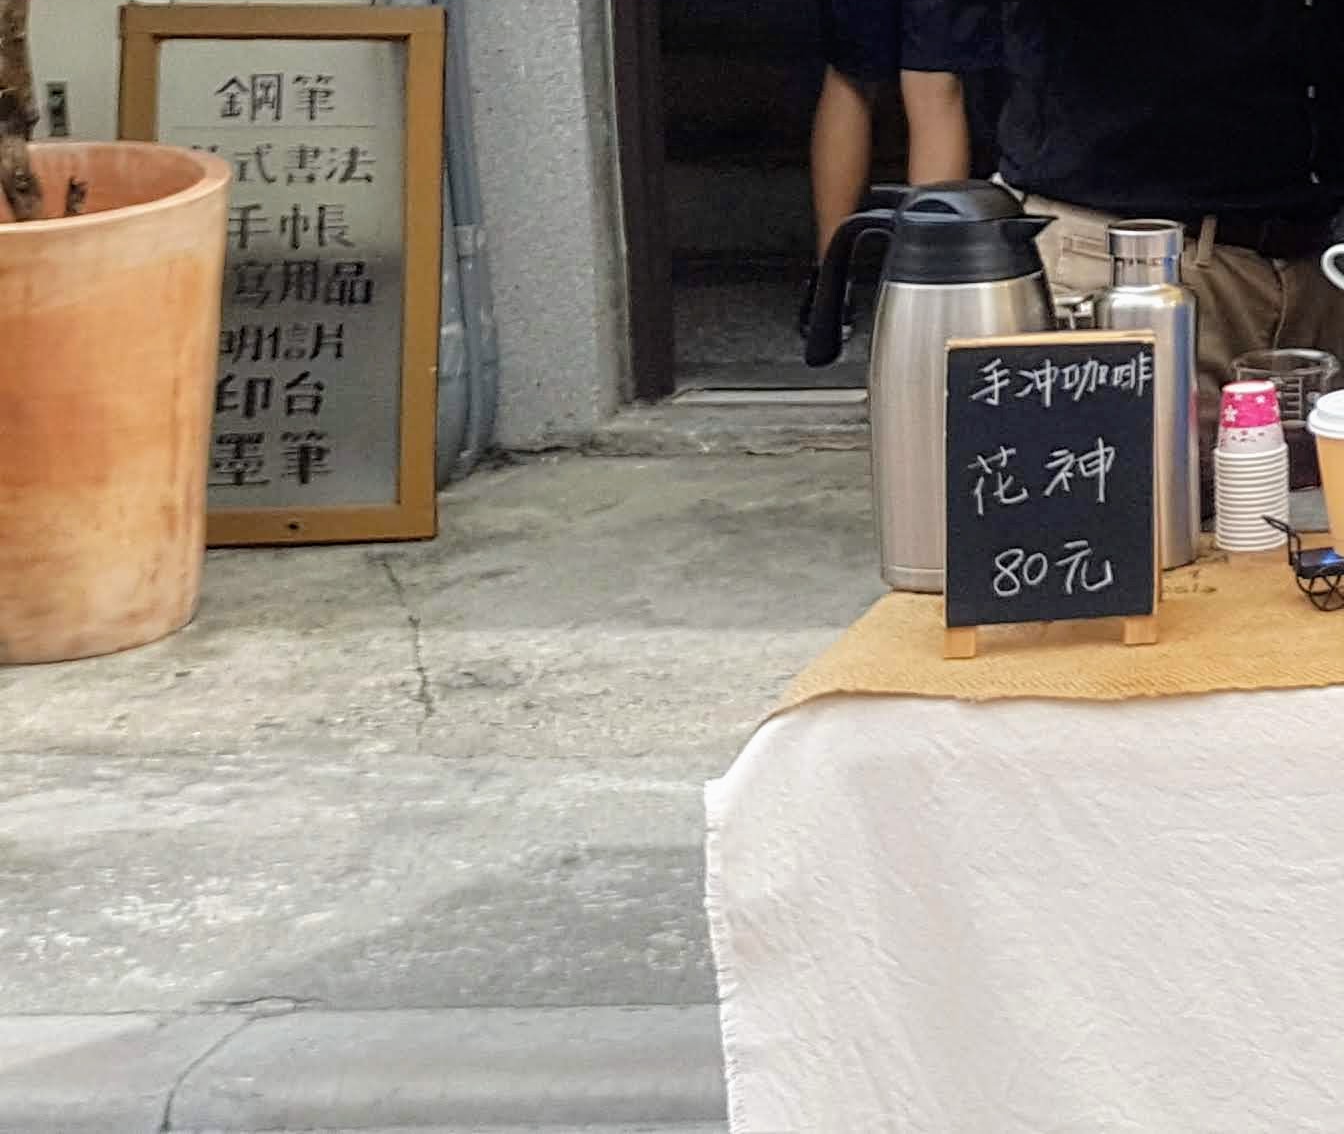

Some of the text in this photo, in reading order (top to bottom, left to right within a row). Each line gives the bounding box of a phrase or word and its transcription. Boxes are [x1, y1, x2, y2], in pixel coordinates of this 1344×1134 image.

[213, 72, 336, 123] 鋼筆
[192, 143, 377, 185] 式書法
[220, 322, 345, 363] 明信片
[215, 371, 325, 420] 印台
[210, 431, 335, 486] 墨筆
[967, 437, 1115, 516] 花神
[992, 538, 1114, 598] 80元
